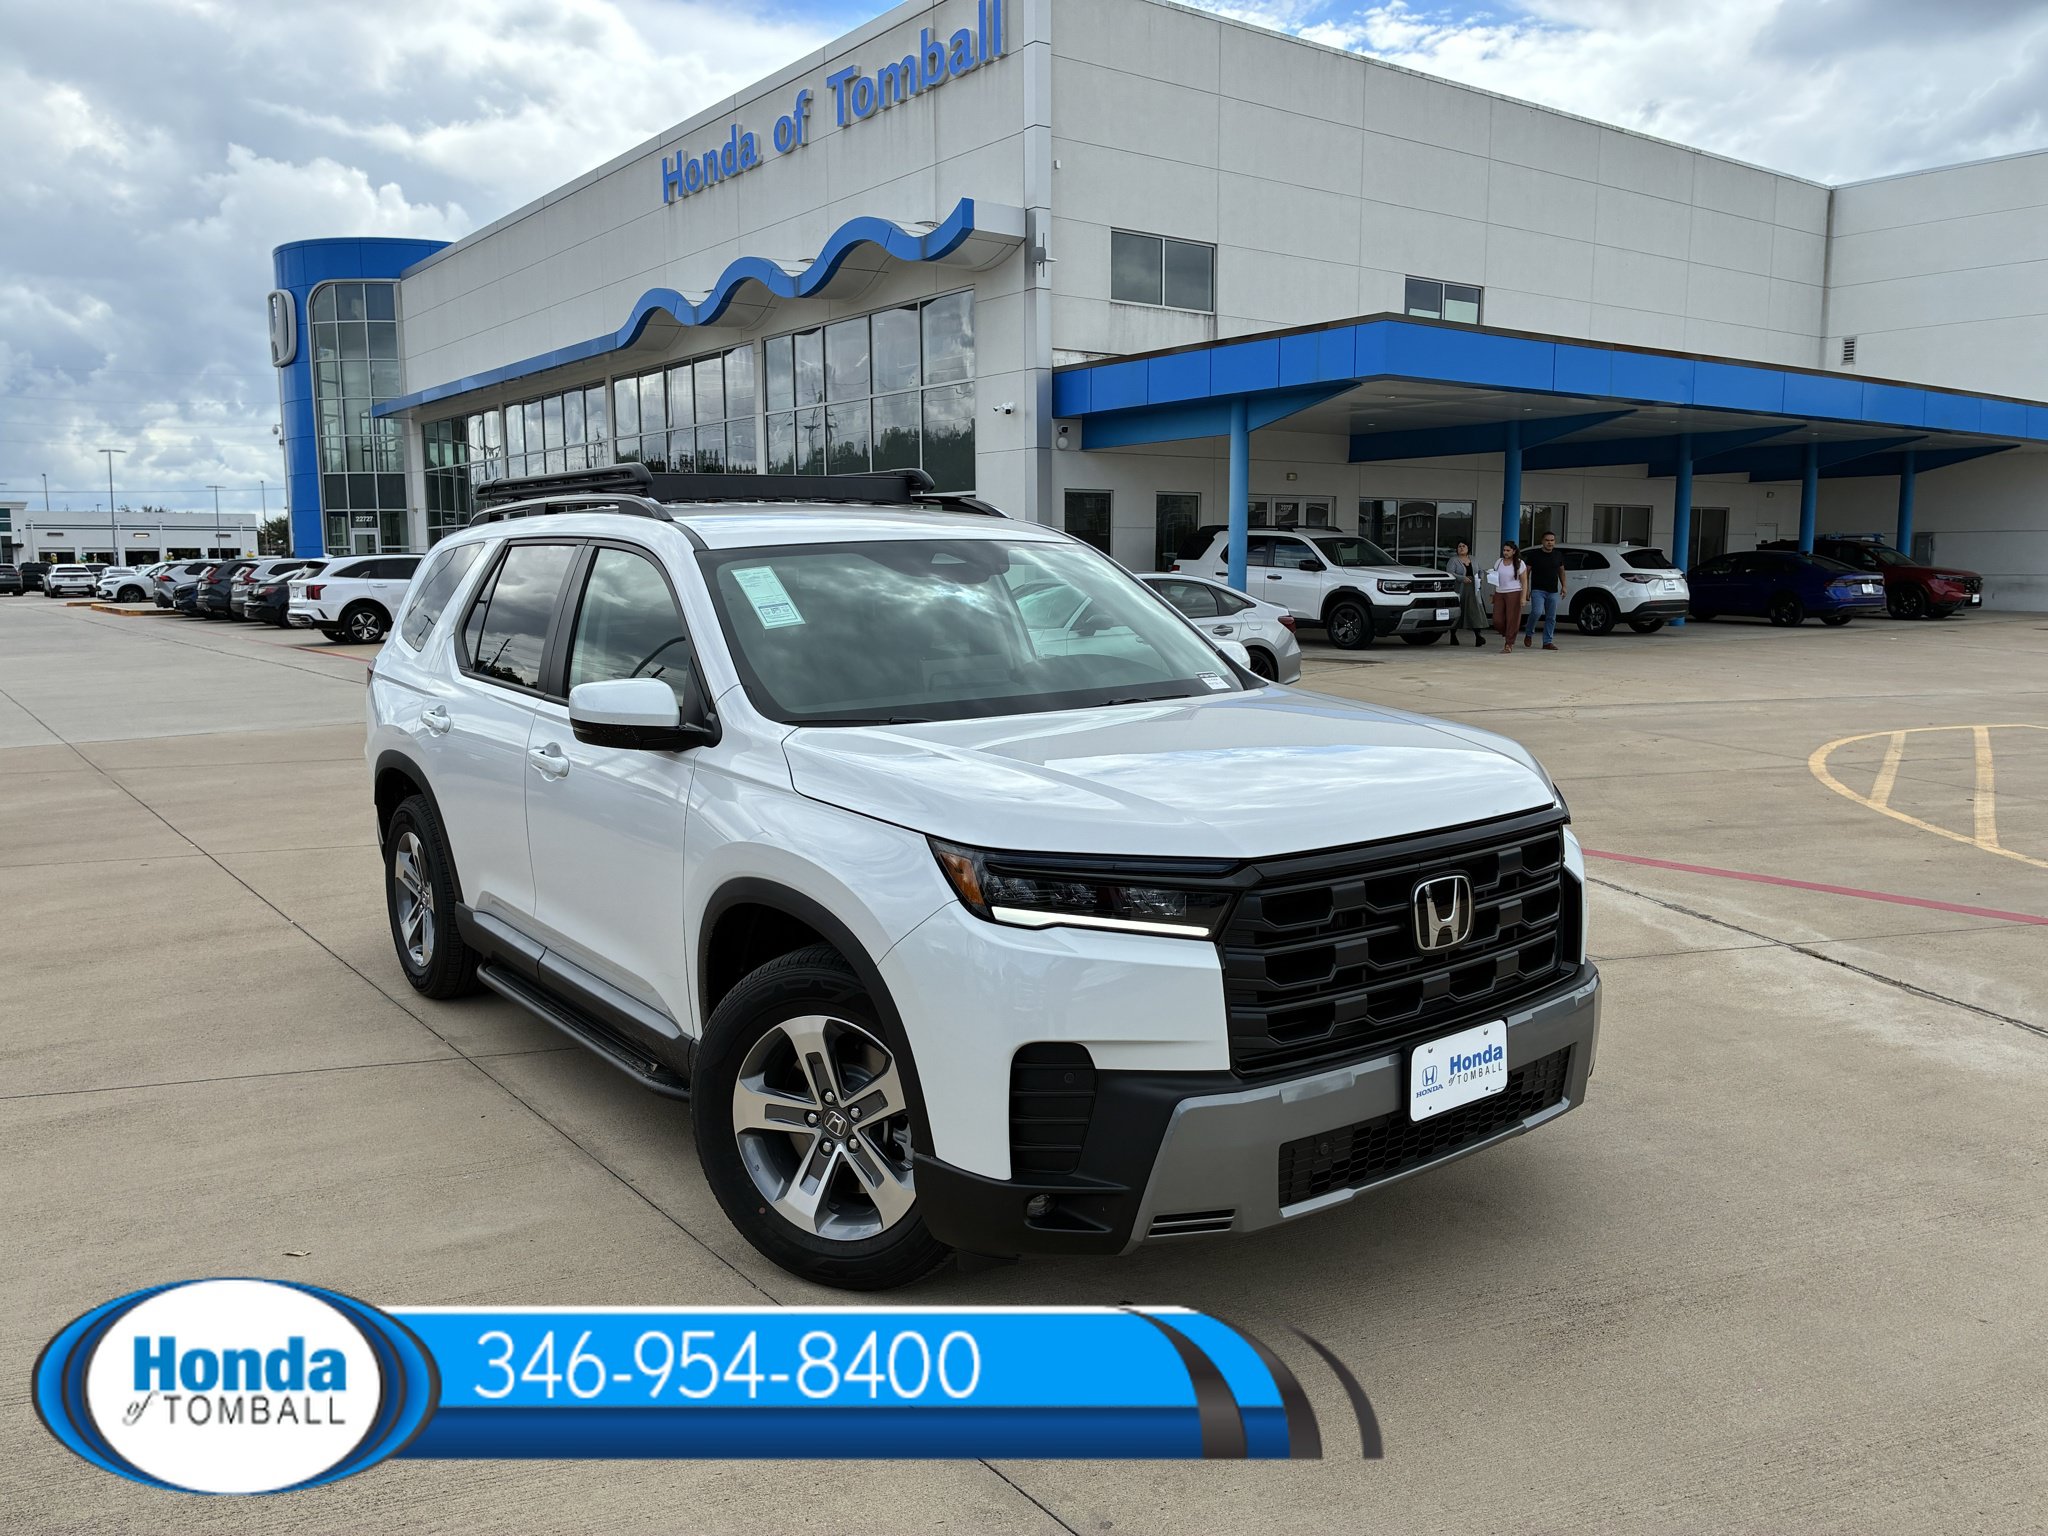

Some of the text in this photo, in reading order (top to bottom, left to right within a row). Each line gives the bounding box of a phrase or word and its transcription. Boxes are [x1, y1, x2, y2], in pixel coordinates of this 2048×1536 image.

[662, 0, 1007, 204] Honda of Tomball
[1450, 1044, 1503, 1075] Honda
[1458, 1062, 1502, 1084] TOMBALL
[1416, 1084, 1443, 1098] HONDA
